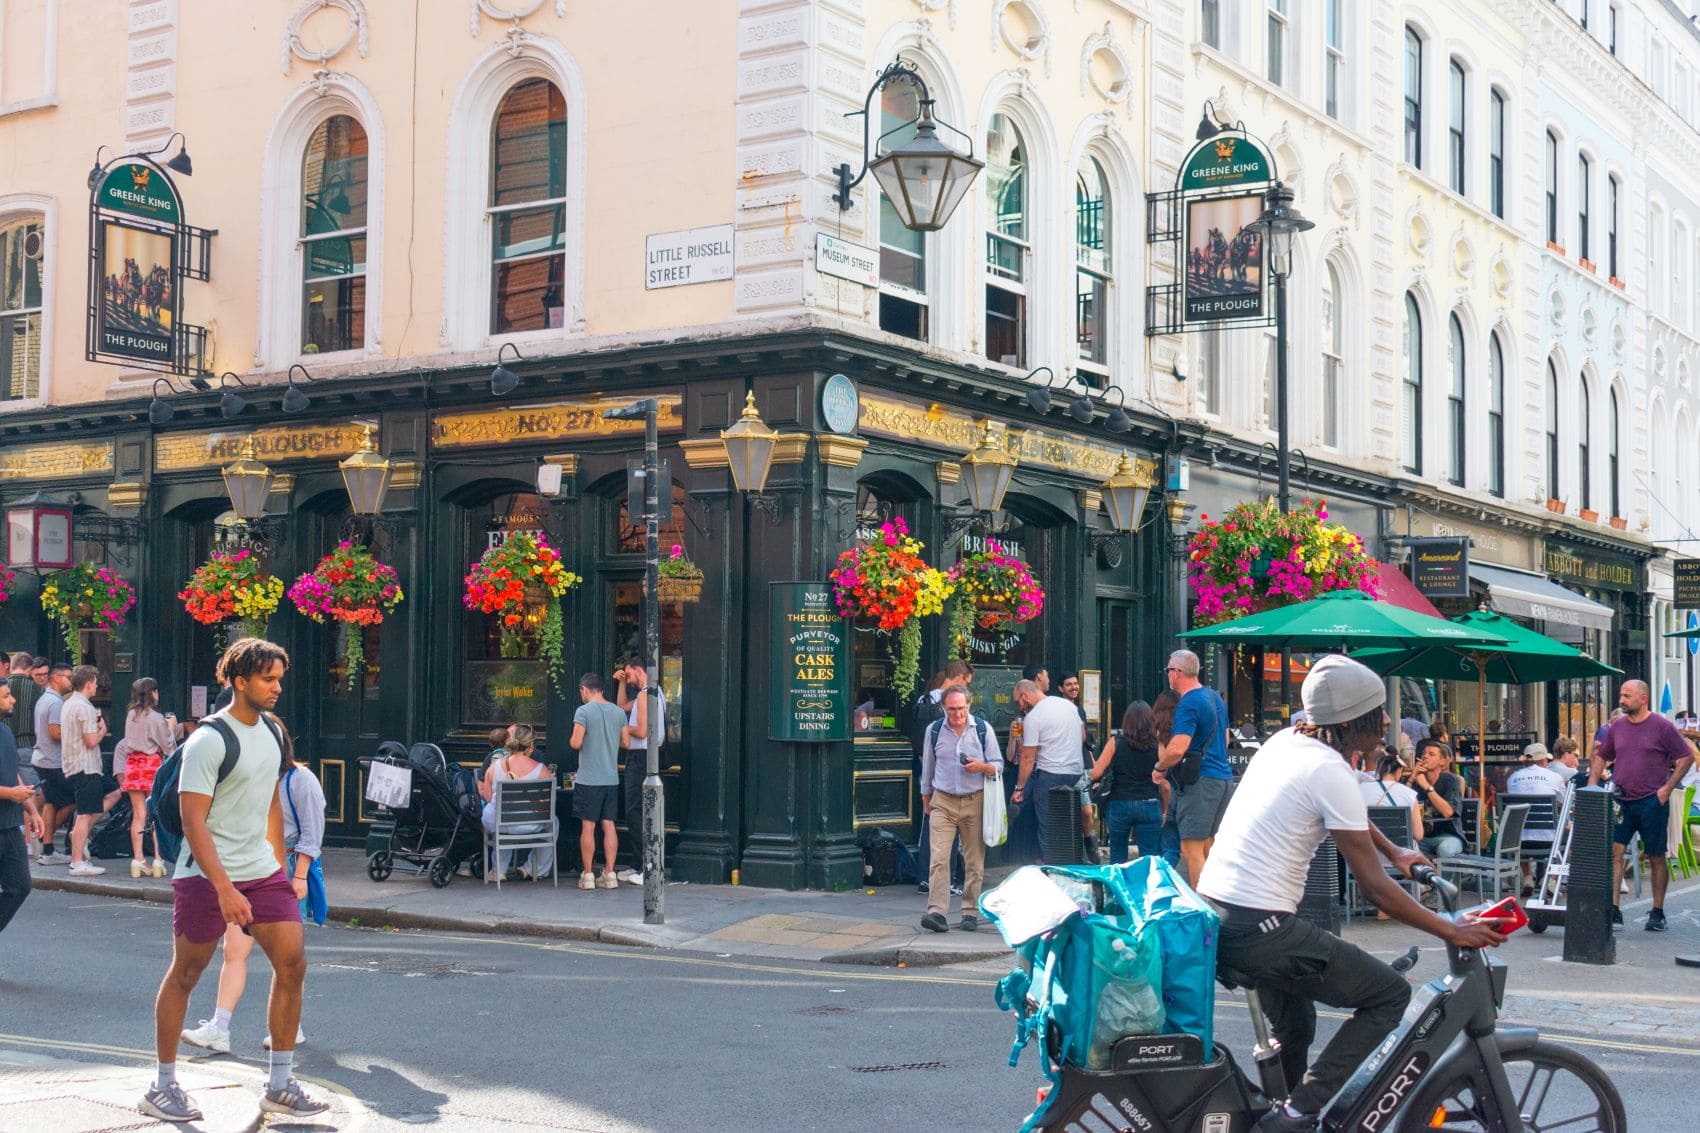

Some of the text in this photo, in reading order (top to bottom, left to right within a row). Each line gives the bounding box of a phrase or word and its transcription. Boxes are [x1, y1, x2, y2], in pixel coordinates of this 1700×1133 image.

[1191, 162, 1259, 179] GREENE KING
[110, 188, 171, 210] GREENE KING
[650, 240, 732, 264] LITTLE RUSSELL
[823, 247, 874, 272] MUSEUM STREET
[650, 265, 692, 283] STREET
[1190, 299, 1259, 313] THE PLOUGH
[105, 333, 168, 353] THE PLOUGH
[564, 409, 595, 430] 27
[498, 514, 535, 523] FAMOUS
[1547, 552, 1632, 585] ABBOTT and HOLDER
[787, 614, 842, 622] THE PLOUGH
[790, 630, 841, 645] PURVEYOR
[1004, 632, 1020, 650] GIN
[794, 654, 835, 666] CASK
[796, 668, 834, 680] ALES
[512, 686, 534, 699] Walker
[1487, 744, 1520, 752] PLOUGH
[1227, 755, 1237, 764] HE
[1139, 1045, 1175, 1055] PORT
[1362, 1056, 1421, 1132] PORT
[1120, 1098, 1153, 1131] 888657
